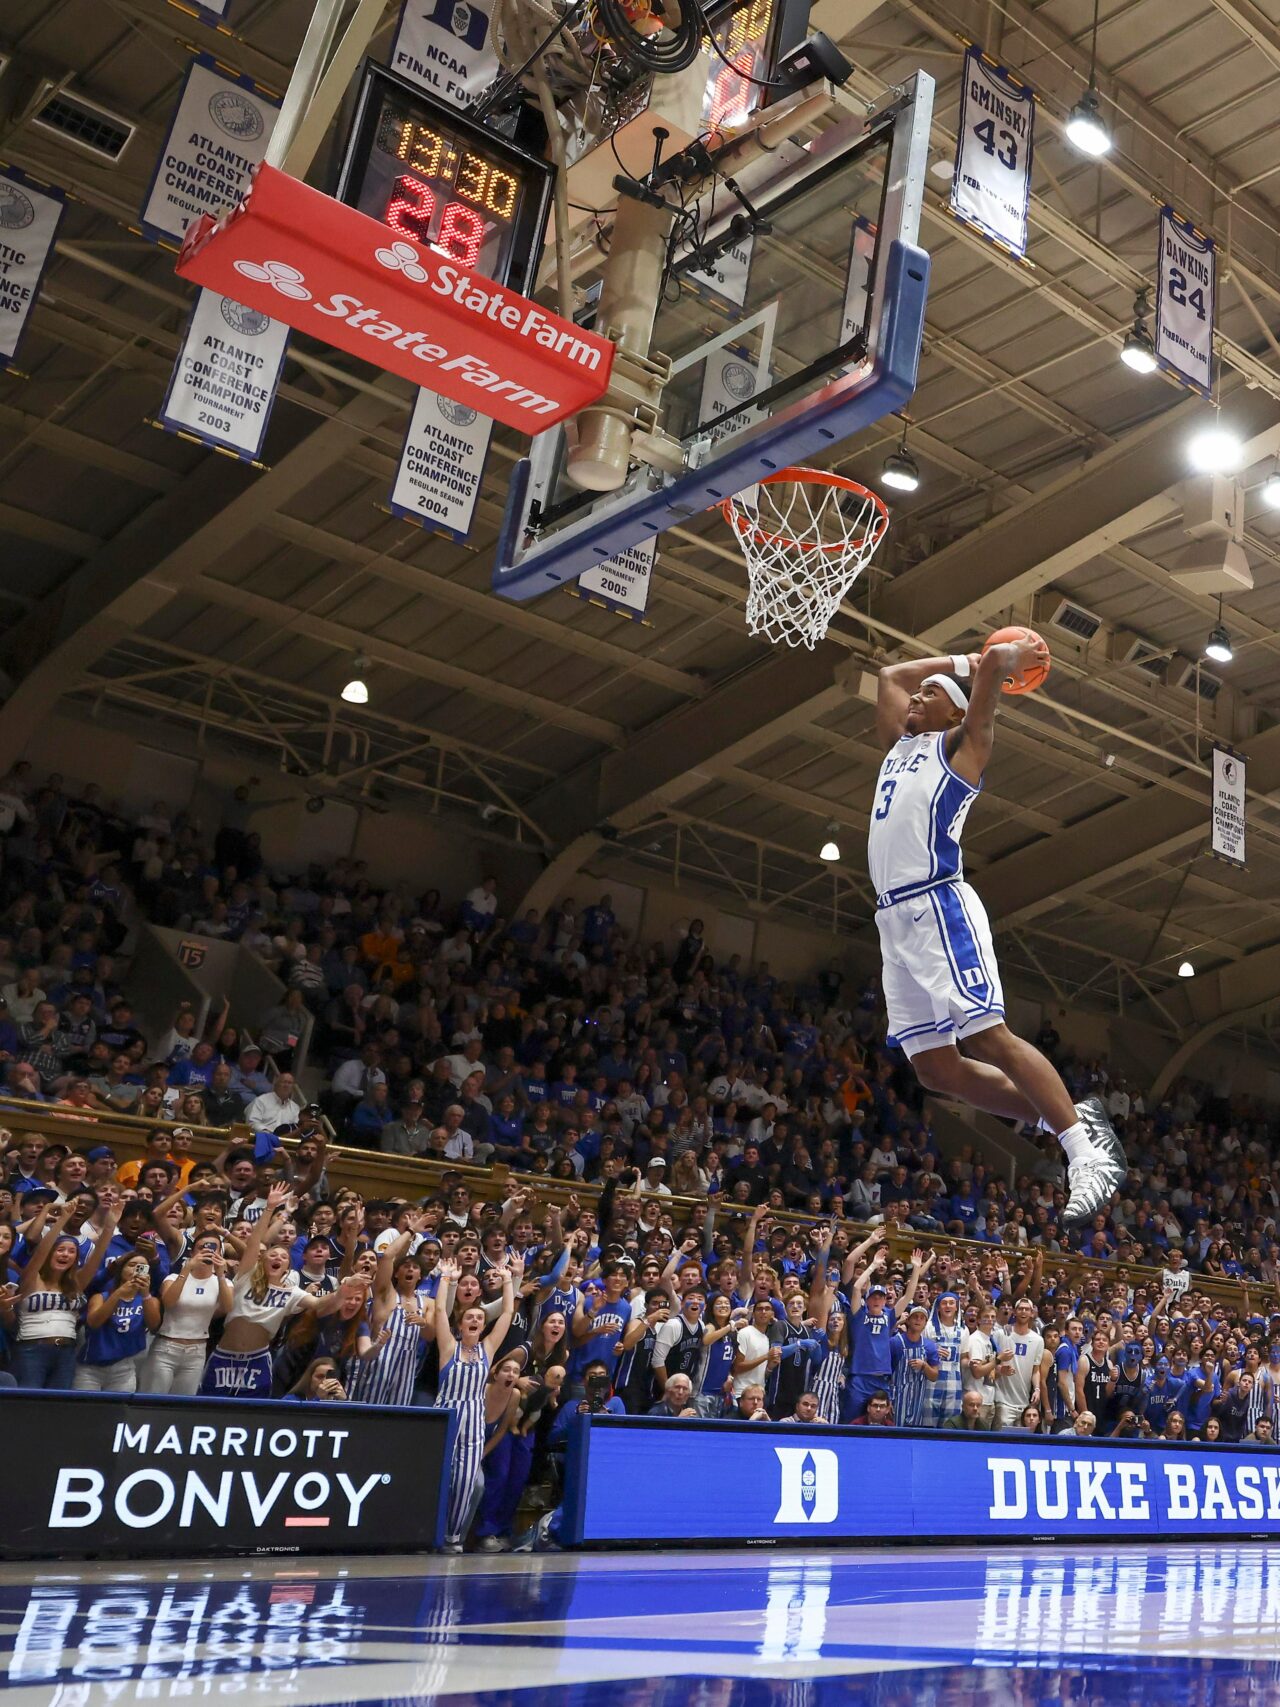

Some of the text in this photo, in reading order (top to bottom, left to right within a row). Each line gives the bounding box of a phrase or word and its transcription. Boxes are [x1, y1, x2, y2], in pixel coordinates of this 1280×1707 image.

[397, 52, 440, 87] FINAL
[427, 45, 467, 78] NCAA
[971, 80, 1026, 138] GMINSKI
[973, 118, 1017, 171] 43
[166, 156, 244, 202] CONFEREN
[196, 153, 244, 184] COAST
[398, 122, 517, 217] 13:30
[387, 177, 483, 267] 28
[1166, 237, 1208, 287] DAWKINS
[1169, 268, 1206, 321] 24
[204, 336, 263, 368] ATLANTIC
[210, 353, 252, 378] COAST
[184, 358, 268, 402] CONFERENCE
[184, 373, 260, 413] CHAMPIONS
[193, 393, 245, 420] TOURNAMENT
[198, 412, 231, 432] 2003
[424, 424, 473, 455] ATLANTIC
[430, 441, 464, 463] COAST
[407, 446, 478, 485] CONFERENCE
[407, 460, 472, 497] CHAMPIONS
[409, 478, 464, 506] REGULAR SEASON
[418, 496, 448, 517] 2004
[598, 563, 635, 583] TOURNAMENT
[601, 578, 627, 596] 2005
[884, 753, 928, 775] UKE
[876, 780, 897, 820] 3
[117, 1319, 130, 1333] 3
[215, 1367, 261, 1389] DUKE
[113, 1423, 349, 1459] MARRIOTT
[987, 1458, 1153, 1520] DUKE
